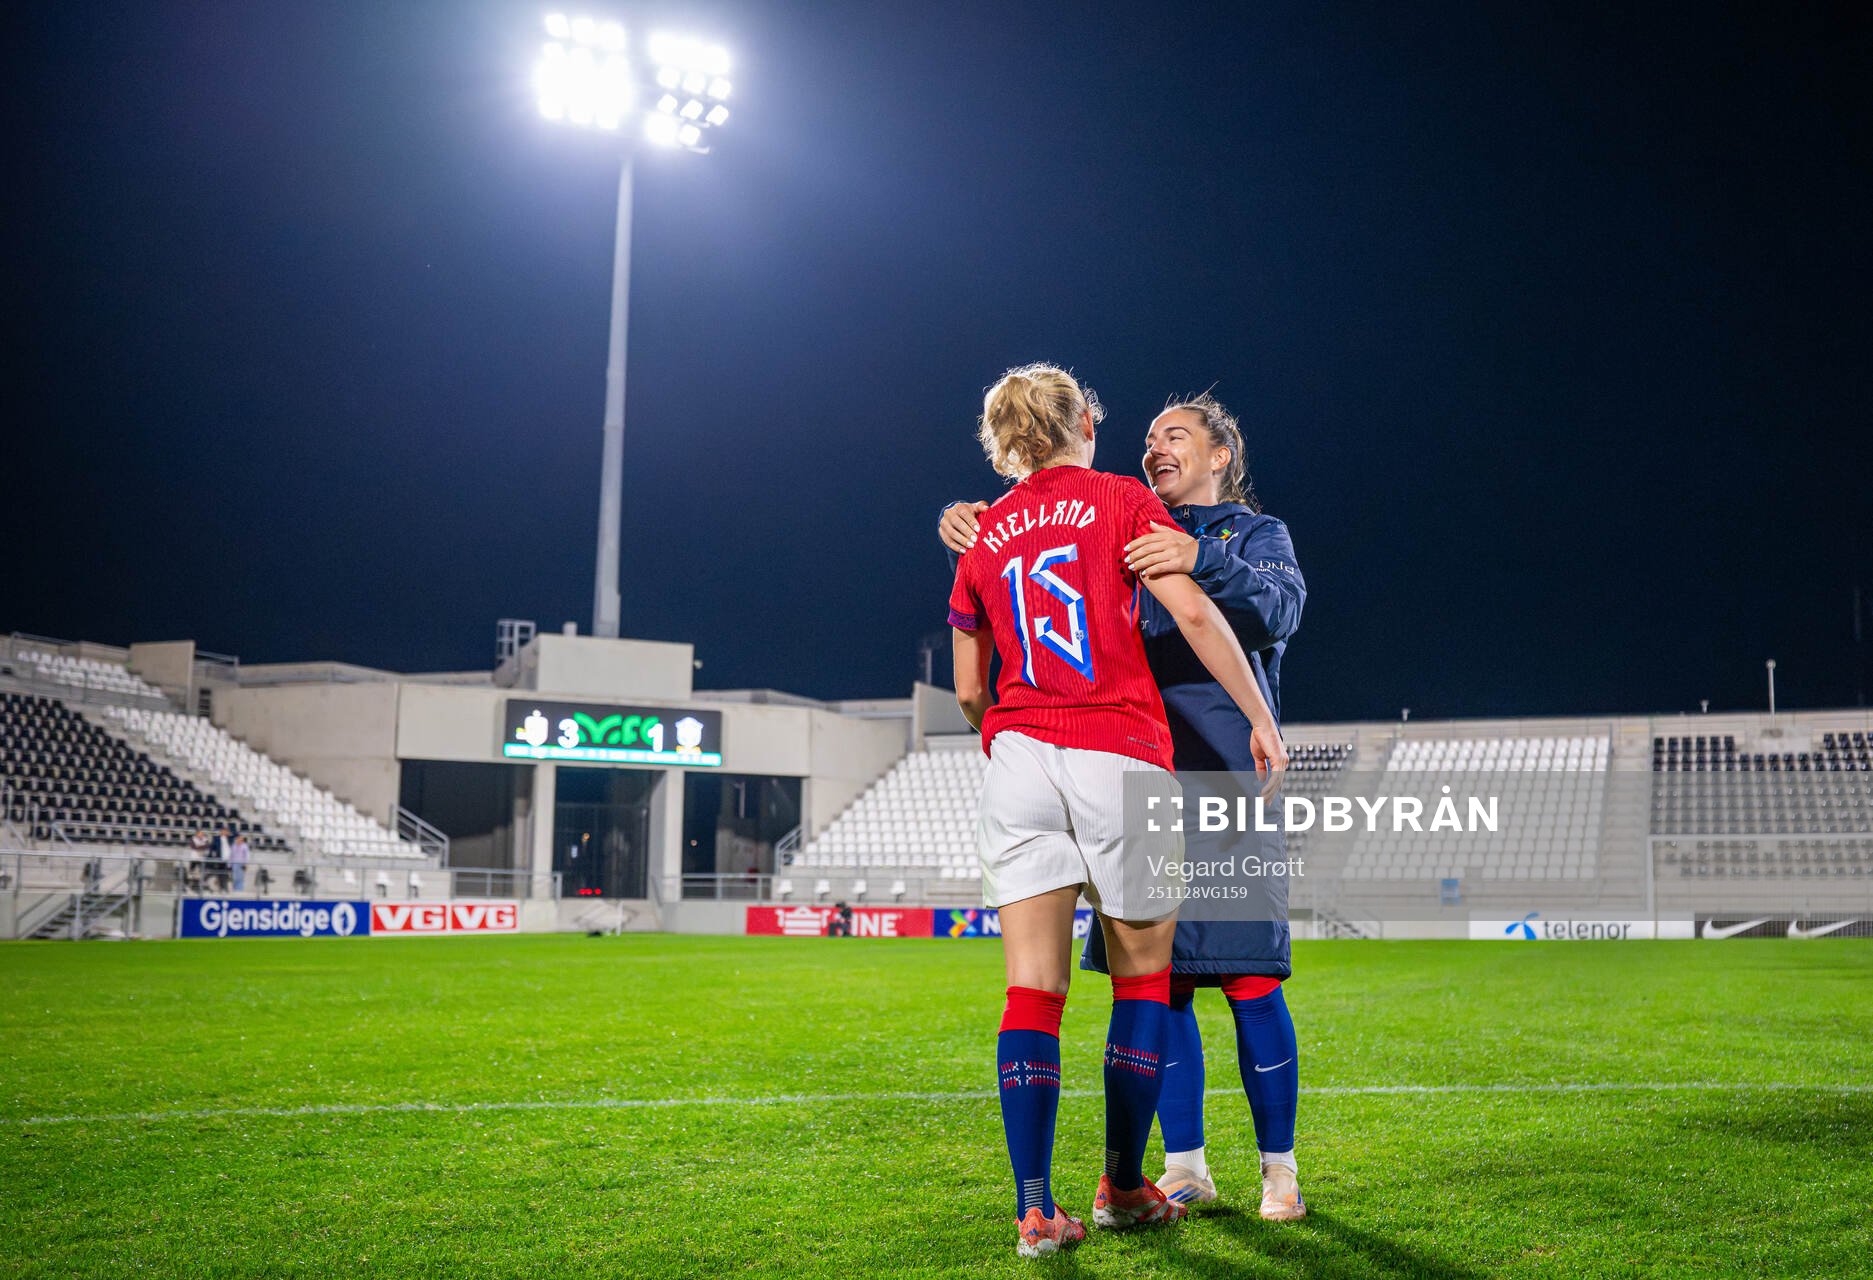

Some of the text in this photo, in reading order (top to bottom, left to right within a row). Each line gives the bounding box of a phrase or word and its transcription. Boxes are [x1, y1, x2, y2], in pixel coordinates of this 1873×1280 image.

[1001, 543, 1095, 688] 15
[558, 718, 664, 753] 3 1
[200, 901, 331, 938] Gjensidige
[374, 905, 445, 931] VG
[454, 904, 515, 930] VG
[834, 912, 898, 937] INE
[1544, 919, 1631, 940] telenor
